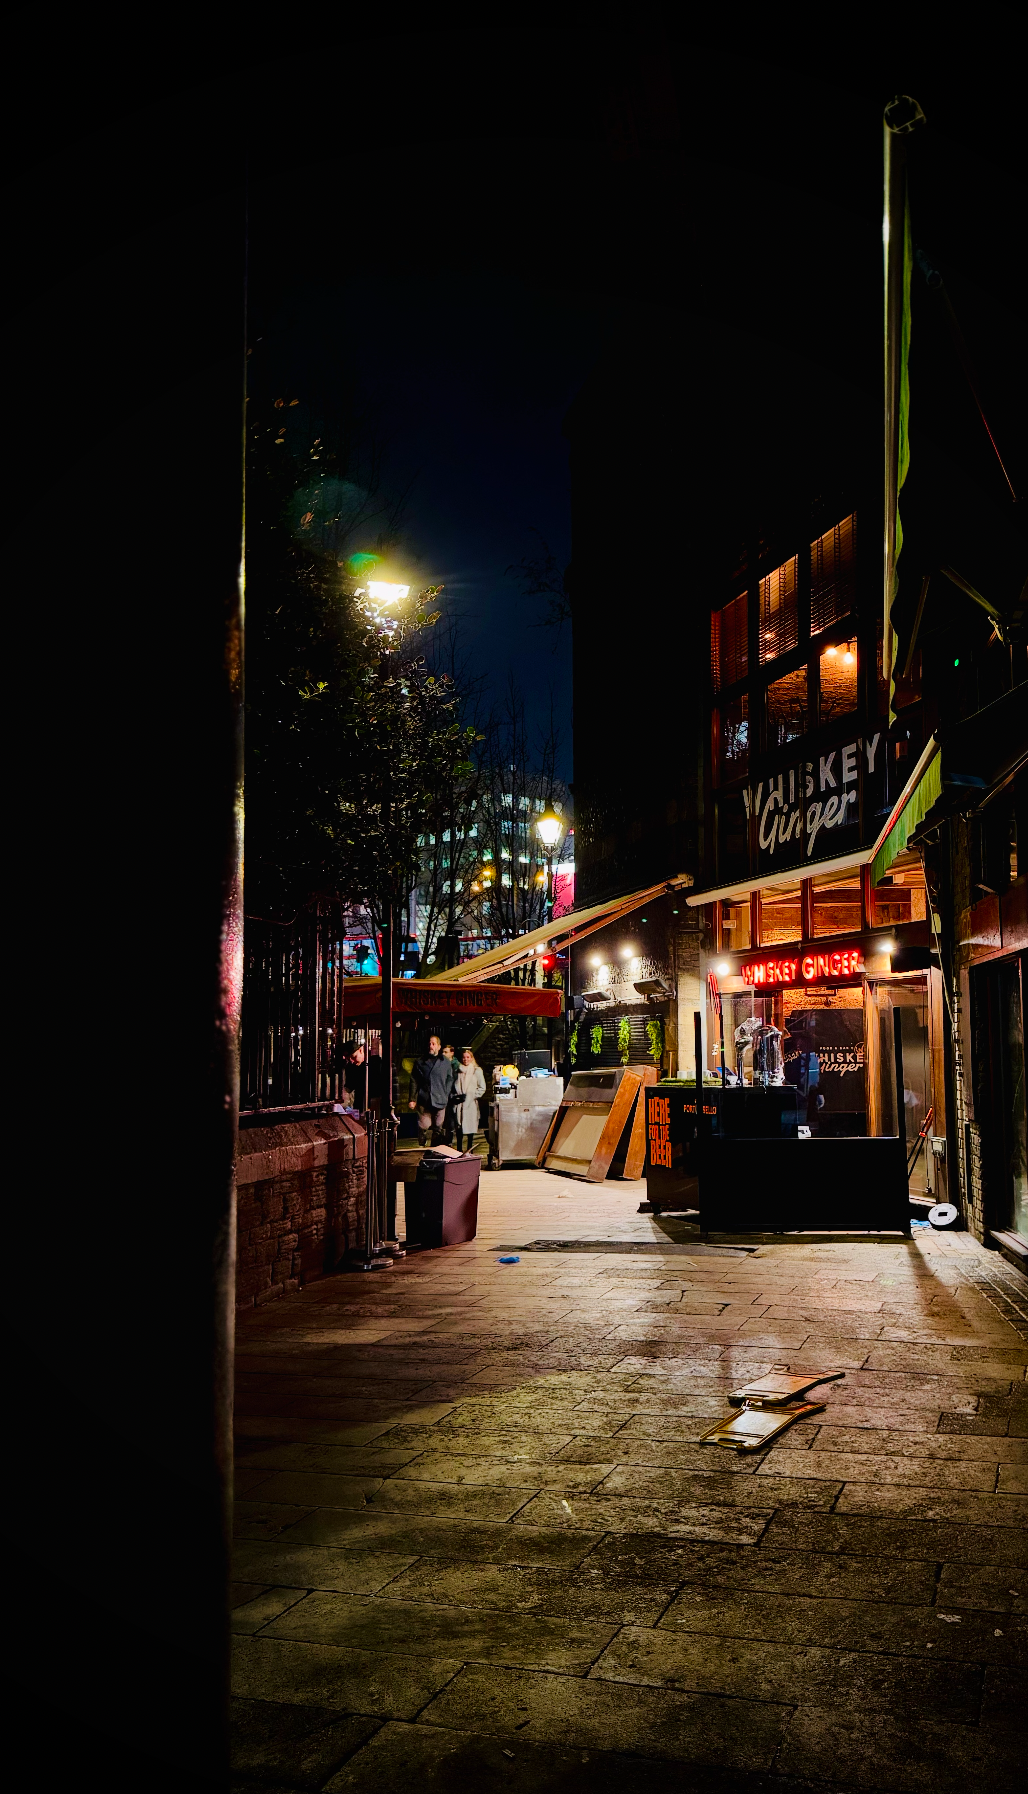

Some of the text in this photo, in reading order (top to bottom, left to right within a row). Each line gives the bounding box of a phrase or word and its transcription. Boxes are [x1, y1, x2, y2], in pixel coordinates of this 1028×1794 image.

[743, 732, 881, 819] WHISKEY
[759, 790, 857, 857] Ginger
[741, 950, 860, 985] WHISKEY GINGER
[398, 988, 499, 1007] WHISKEY GINGER
[648, 1096, 671, 1125] HERE
[648, 1124, 670, 1141] FOR THE
[650, 1139, 672, 1168] BEER
